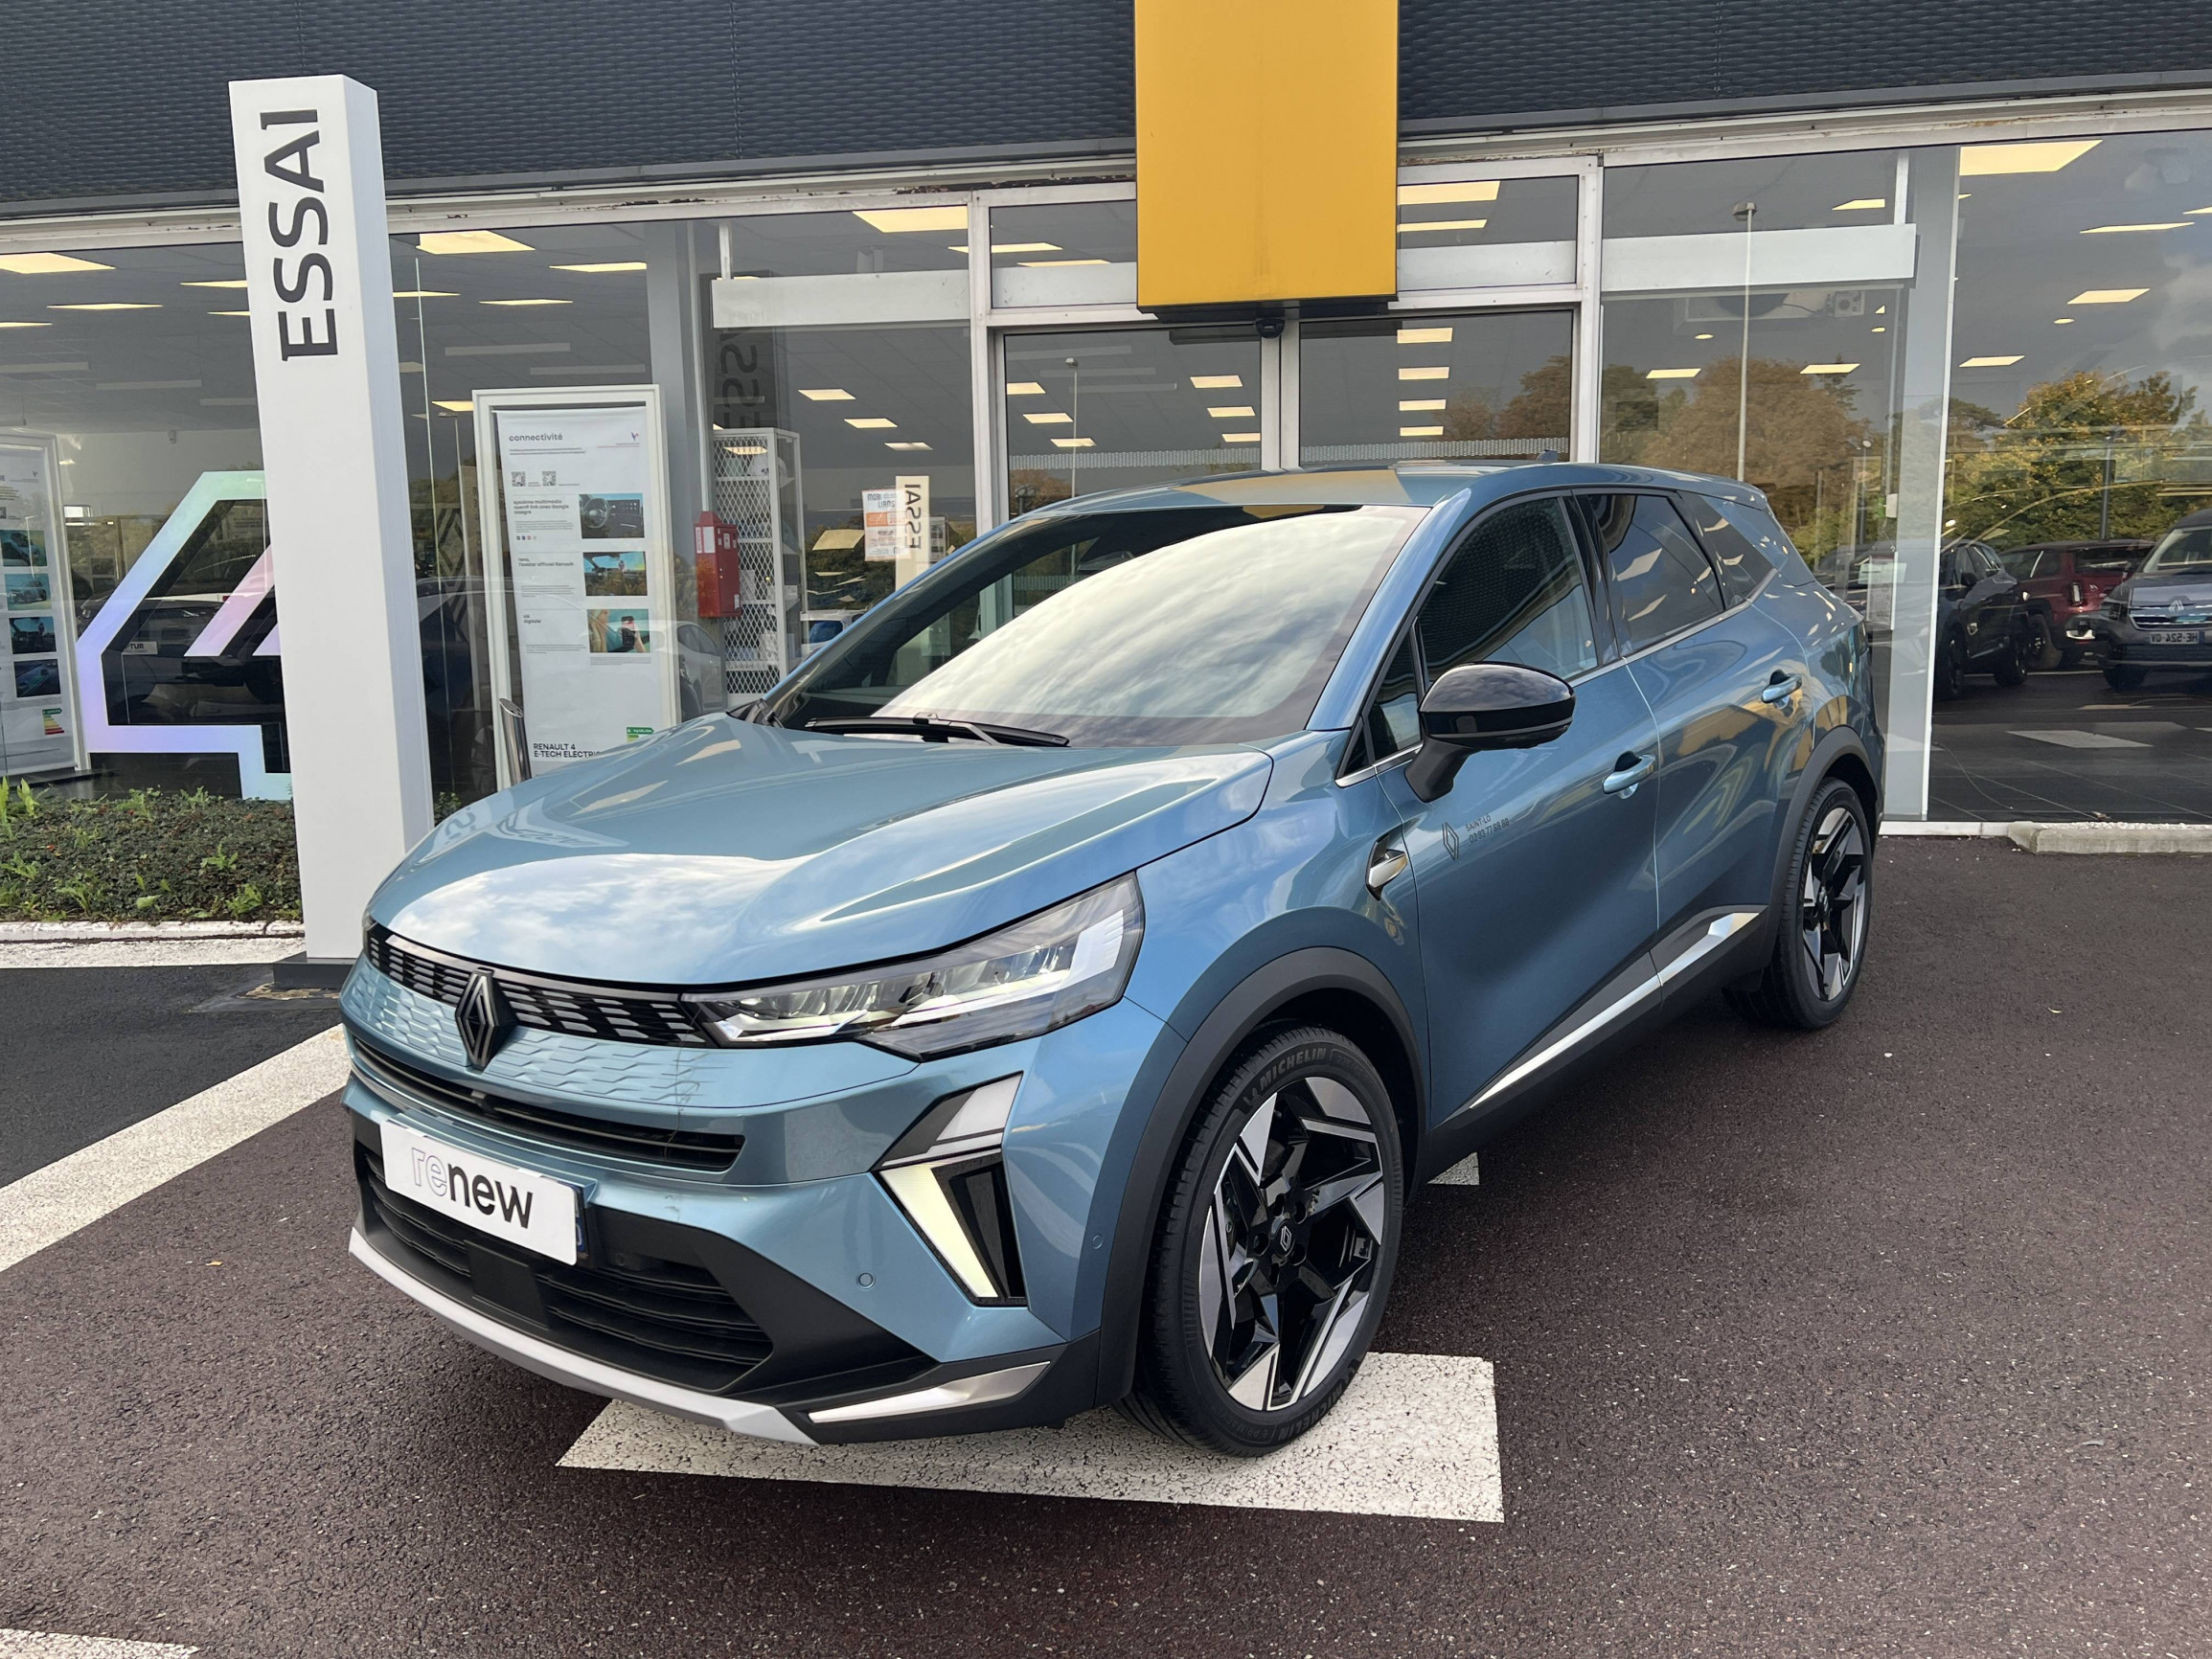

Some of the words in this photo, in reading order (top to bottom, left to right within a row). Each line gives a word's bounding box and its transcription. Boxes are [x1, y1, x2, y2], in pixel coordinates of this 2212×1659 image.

[260, 109, 338, 361] ESSAI
[509, 433, 562, 442] connectivité
[1260, 1048, 1327, 1091] MICHELIN
[411, 1148, 534, 1229] renew
